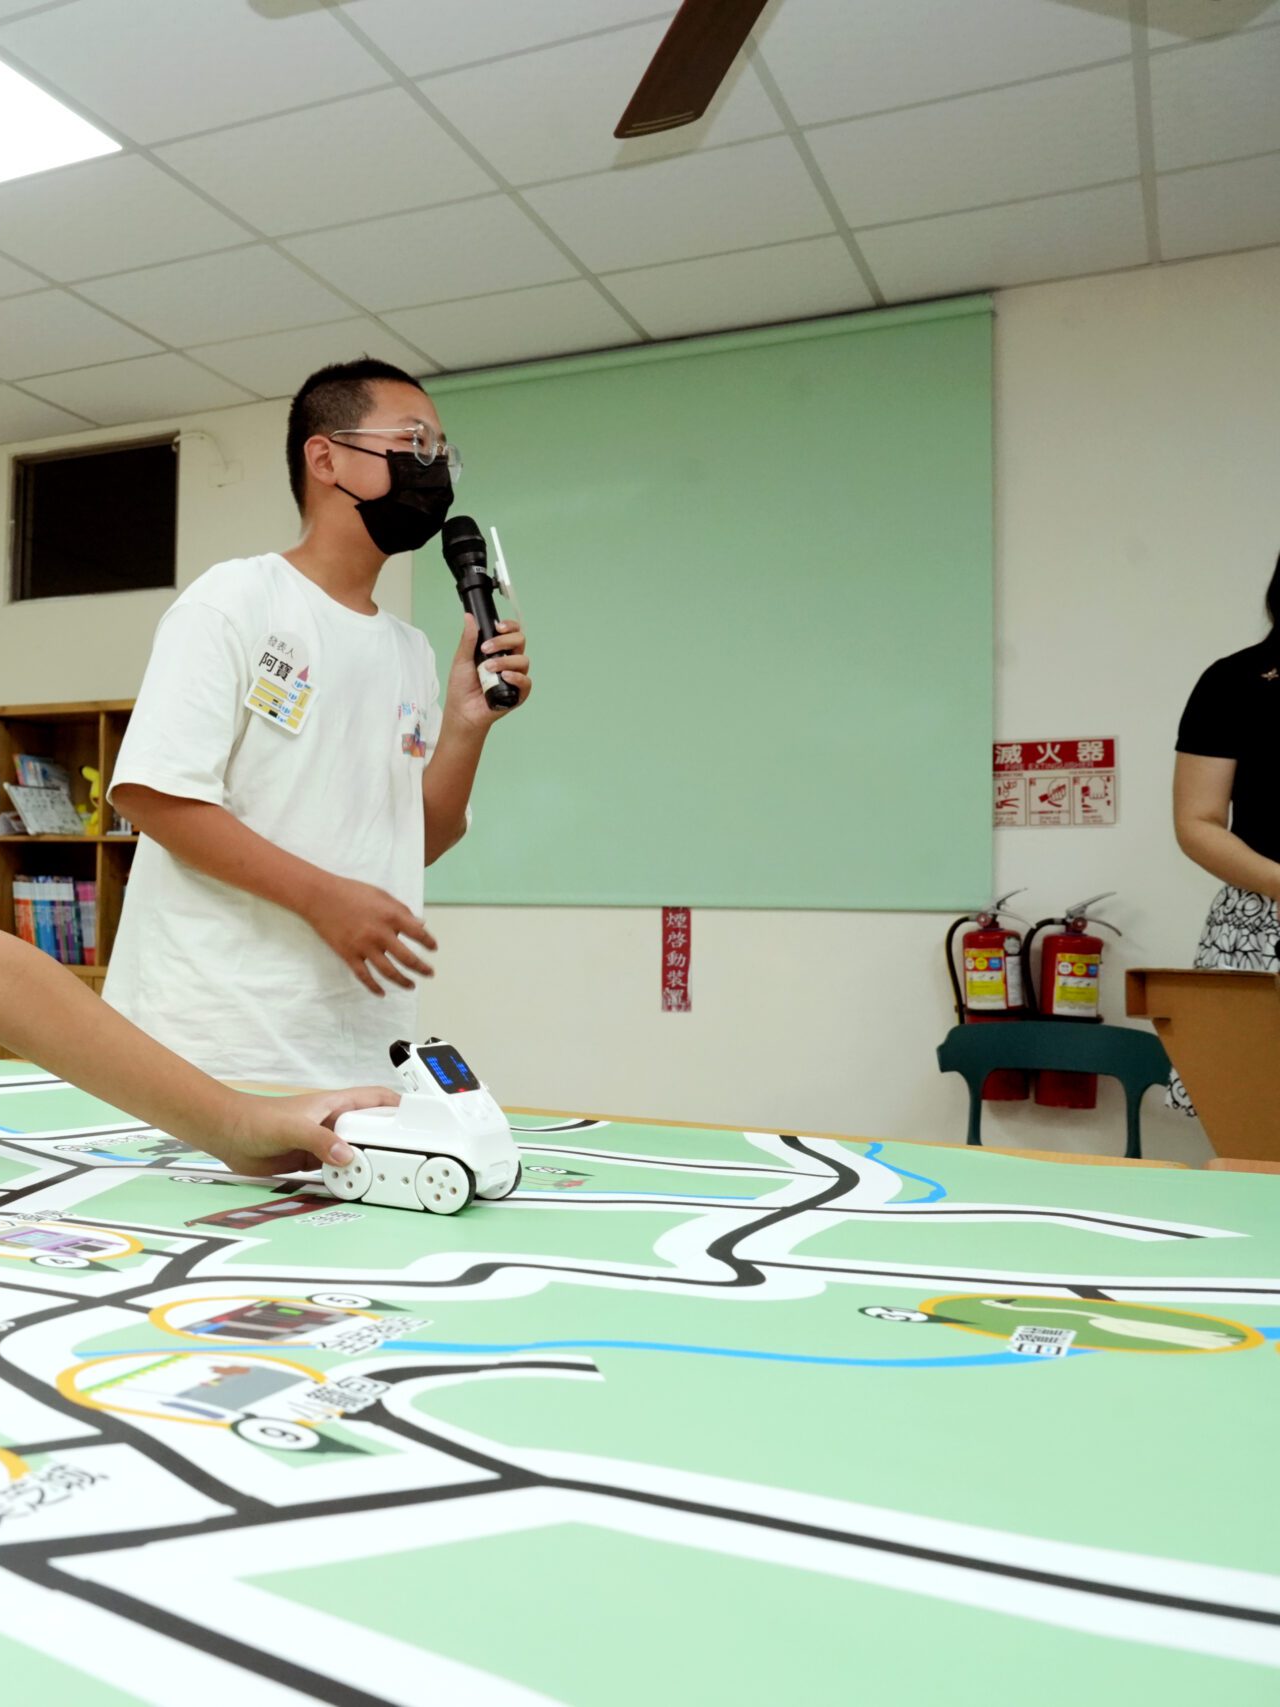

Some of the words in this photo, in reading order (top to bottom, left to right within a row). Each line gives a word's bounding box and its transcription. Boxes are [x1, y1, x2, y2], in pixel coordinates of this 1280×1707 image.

[267, 635, 295, 659] 發表人
[258, 652, 294, 682] 阿寶
[995, 741, 1104, 764] 滅火器
[259, 1426, 302, 1443] 9
